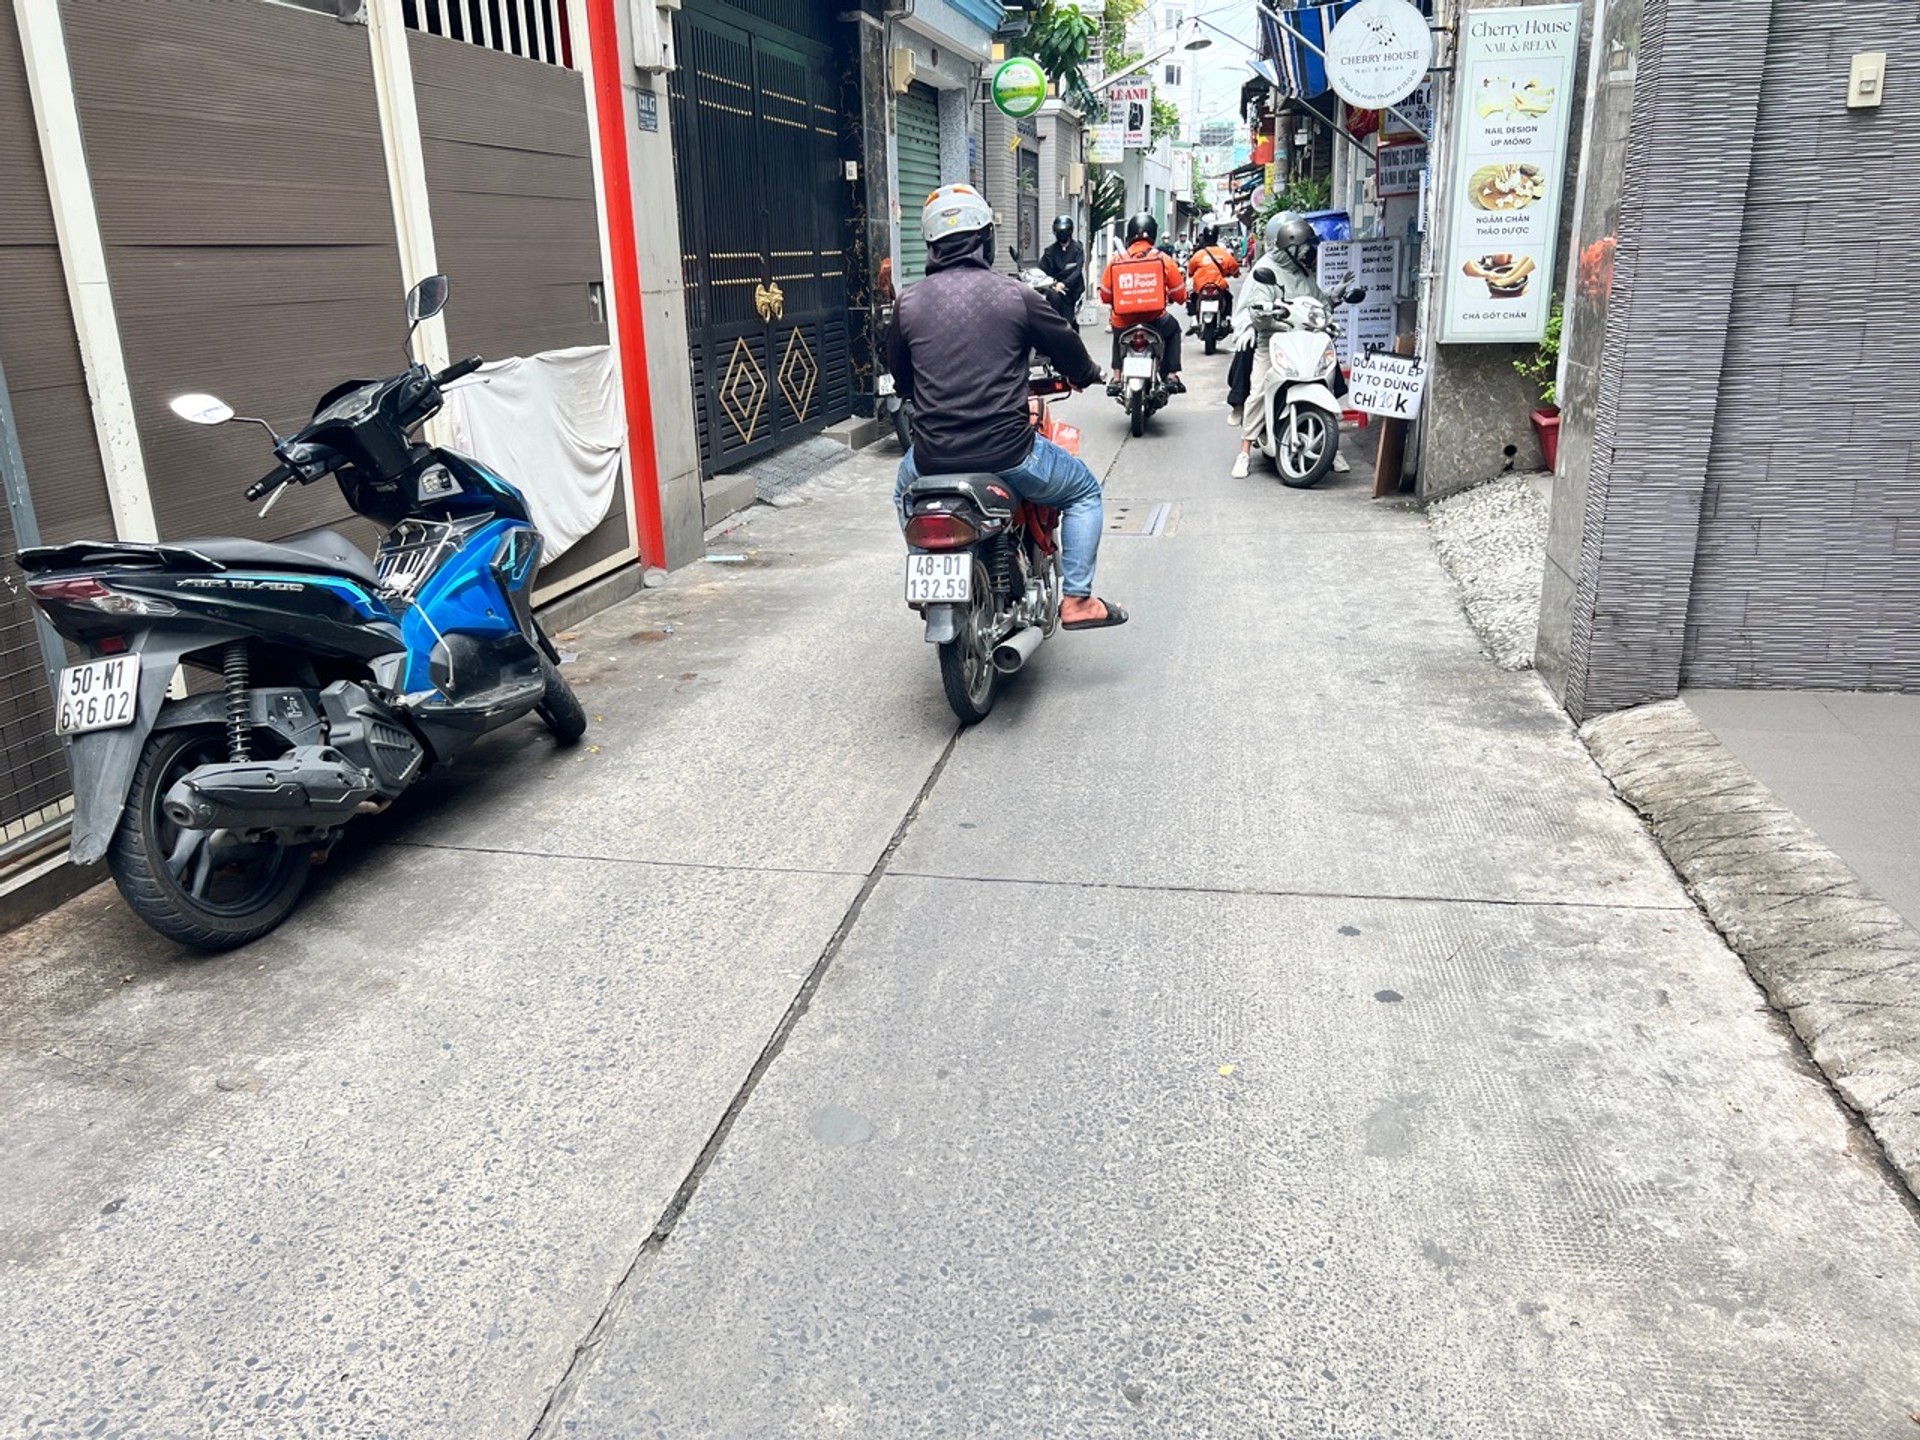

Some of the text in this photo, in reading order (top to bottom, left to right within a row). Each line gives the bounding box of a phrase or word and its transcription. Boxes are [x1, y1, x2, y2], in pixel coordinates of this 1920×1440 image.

[1471, 19, 1572, 38] Cherry House
[1485, 39, 1557, 53] NAIL & RELAX
[1340, 50, 1419, 65] CHERRY HOUSE
[1125, 88, 1148, 100] ANH
[1485, 125, 1538, 135] NAIL DESIGN
[1503, 136, 1532, 145] MÓNG
[1476, 213, 1530, 223] NGÂM CHÂN
[1476, 226, 1500, 235] THẢO
[1502, 309, 1527, 319] CHÂN
[1352, 372, 1419, 393] LY TO ĐÙNG
[1354, 390, 1378, 408] CHỈ
[916, 555, 961, 576] 48-D1
[229, 580, 305, 592] BLADE
[910, 578, 968, 599] 132.59
[71, 660, 124, 696] 50-N1
[62, 691, 129, 730] 636.02
